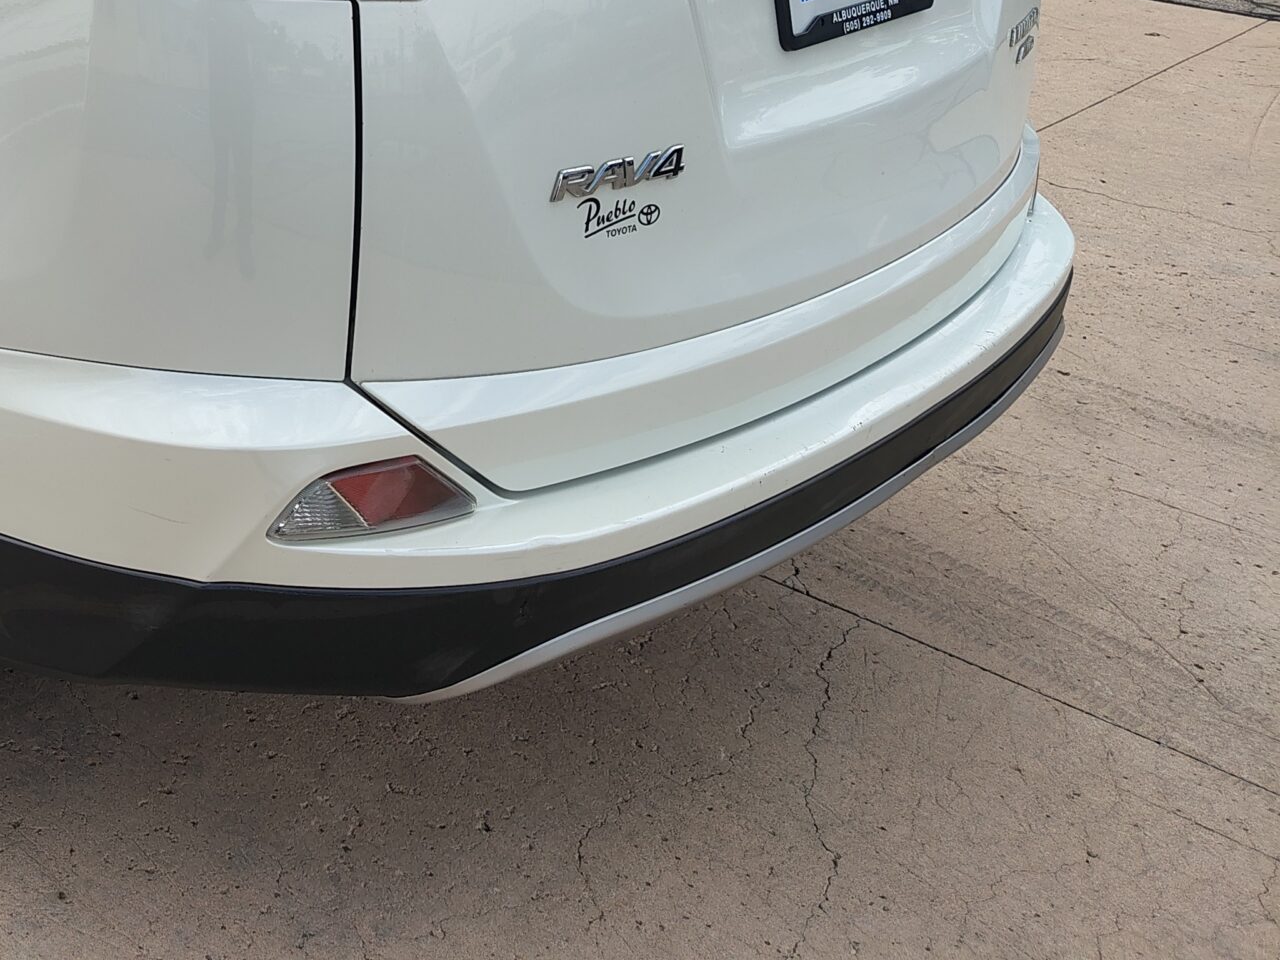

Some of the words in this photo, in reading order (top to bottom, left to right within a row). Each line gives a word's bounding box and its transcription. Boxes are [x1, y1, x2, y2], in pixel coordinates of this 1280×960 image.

[843, 18, 861, 34] (505)
[549, 143, 686, 202] RAV4
[577, 197, 636, 233] Pueblo
[606, 224, 637, 238] TOYOTA
